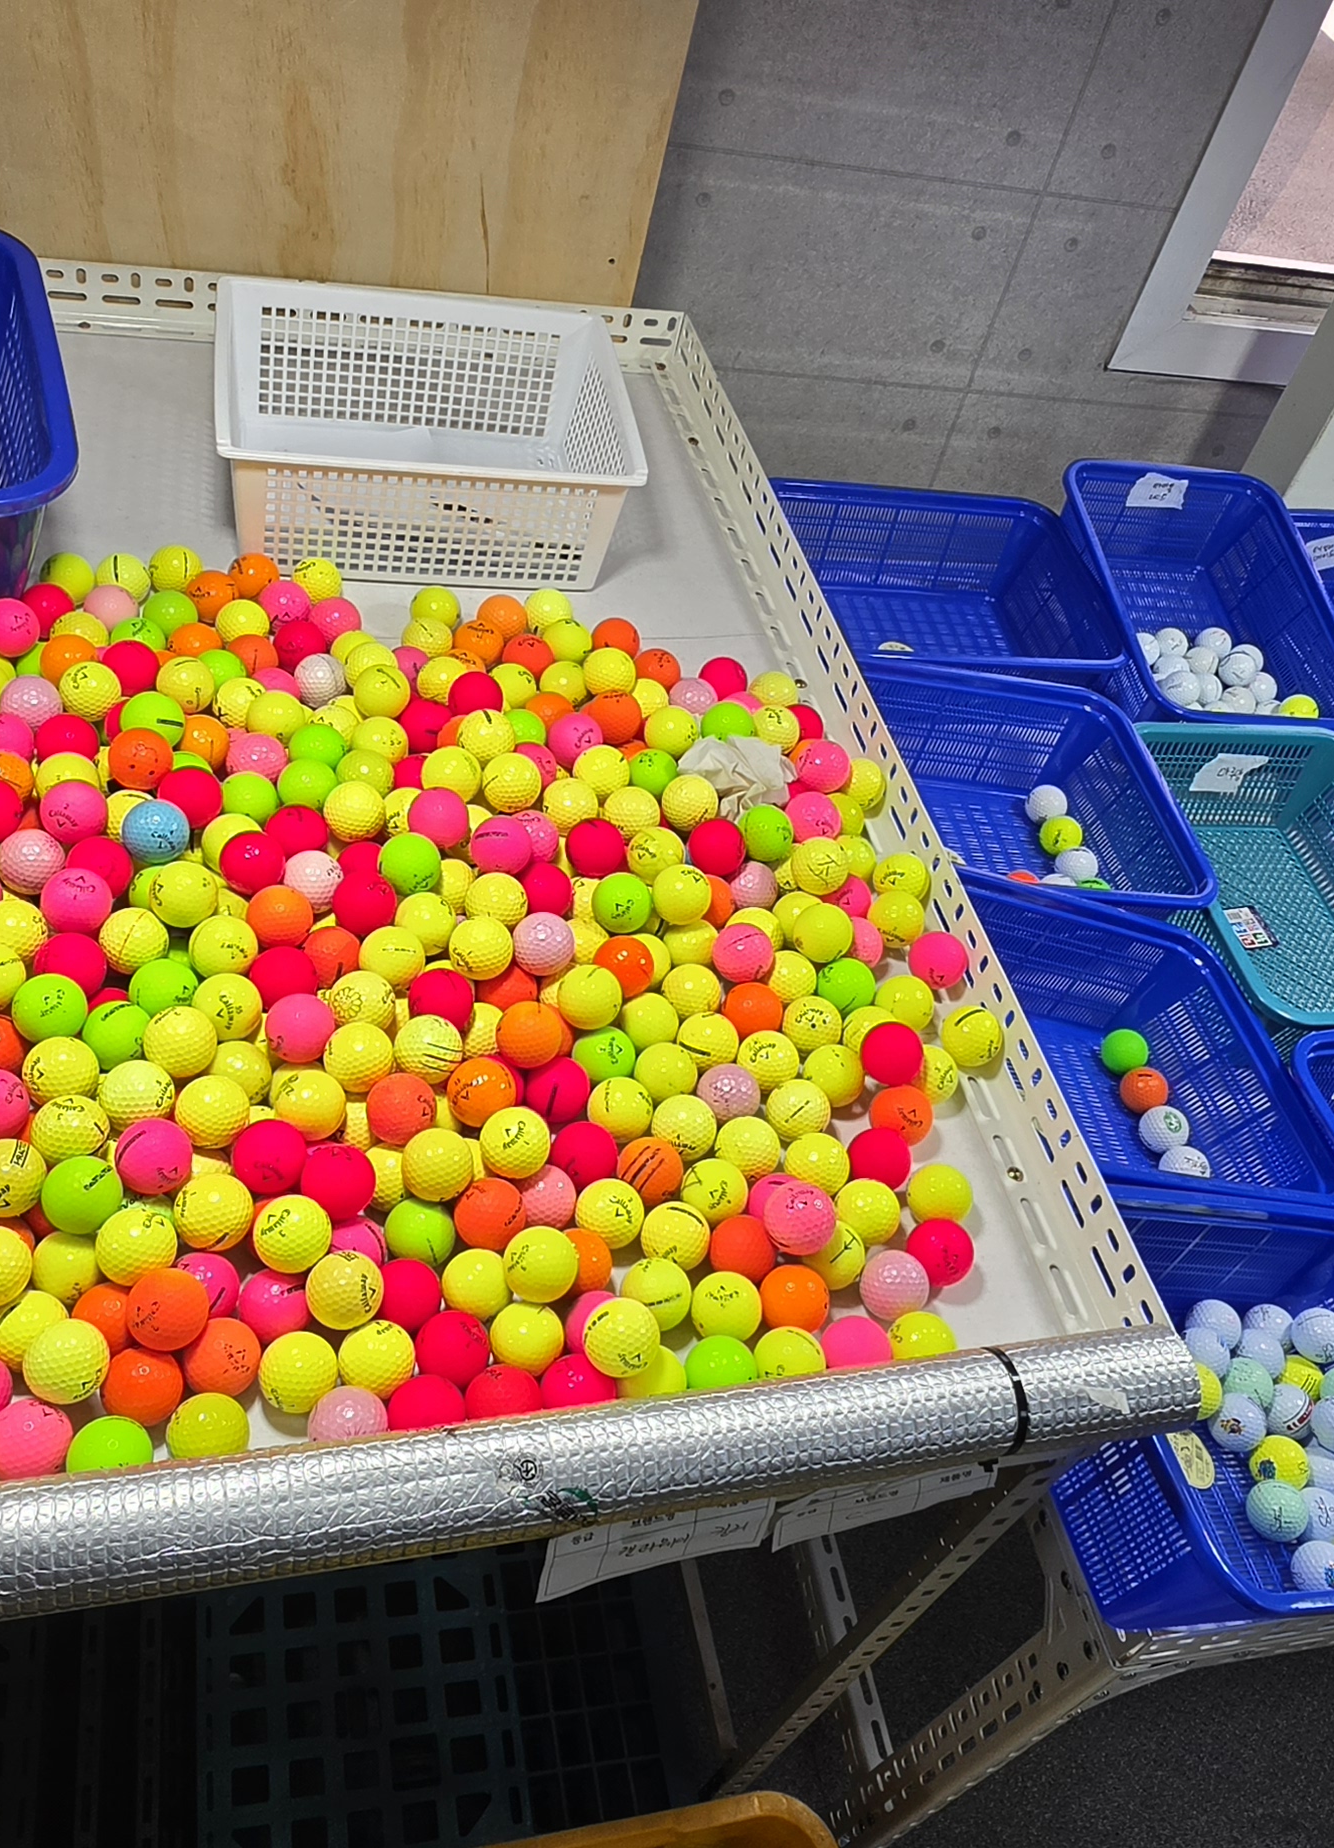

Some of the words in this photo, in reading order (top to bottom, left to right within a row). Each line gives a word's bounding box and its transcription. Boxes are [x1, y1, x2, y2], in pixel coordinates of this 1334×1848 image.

[48, 809, 79, 828] Callaway
[62, 876, 97, 896] Callaway
[876, 871, 906, 890] Callaway
[218, 994, 238, 1031] Callaway
[501, 1121, 528, 1150] Callaway
[606, 1195, 634, 1220] Callaway
[259, 1208, 292, 1237] Callaway
[361, 1272, 374, 1314] Callaway
